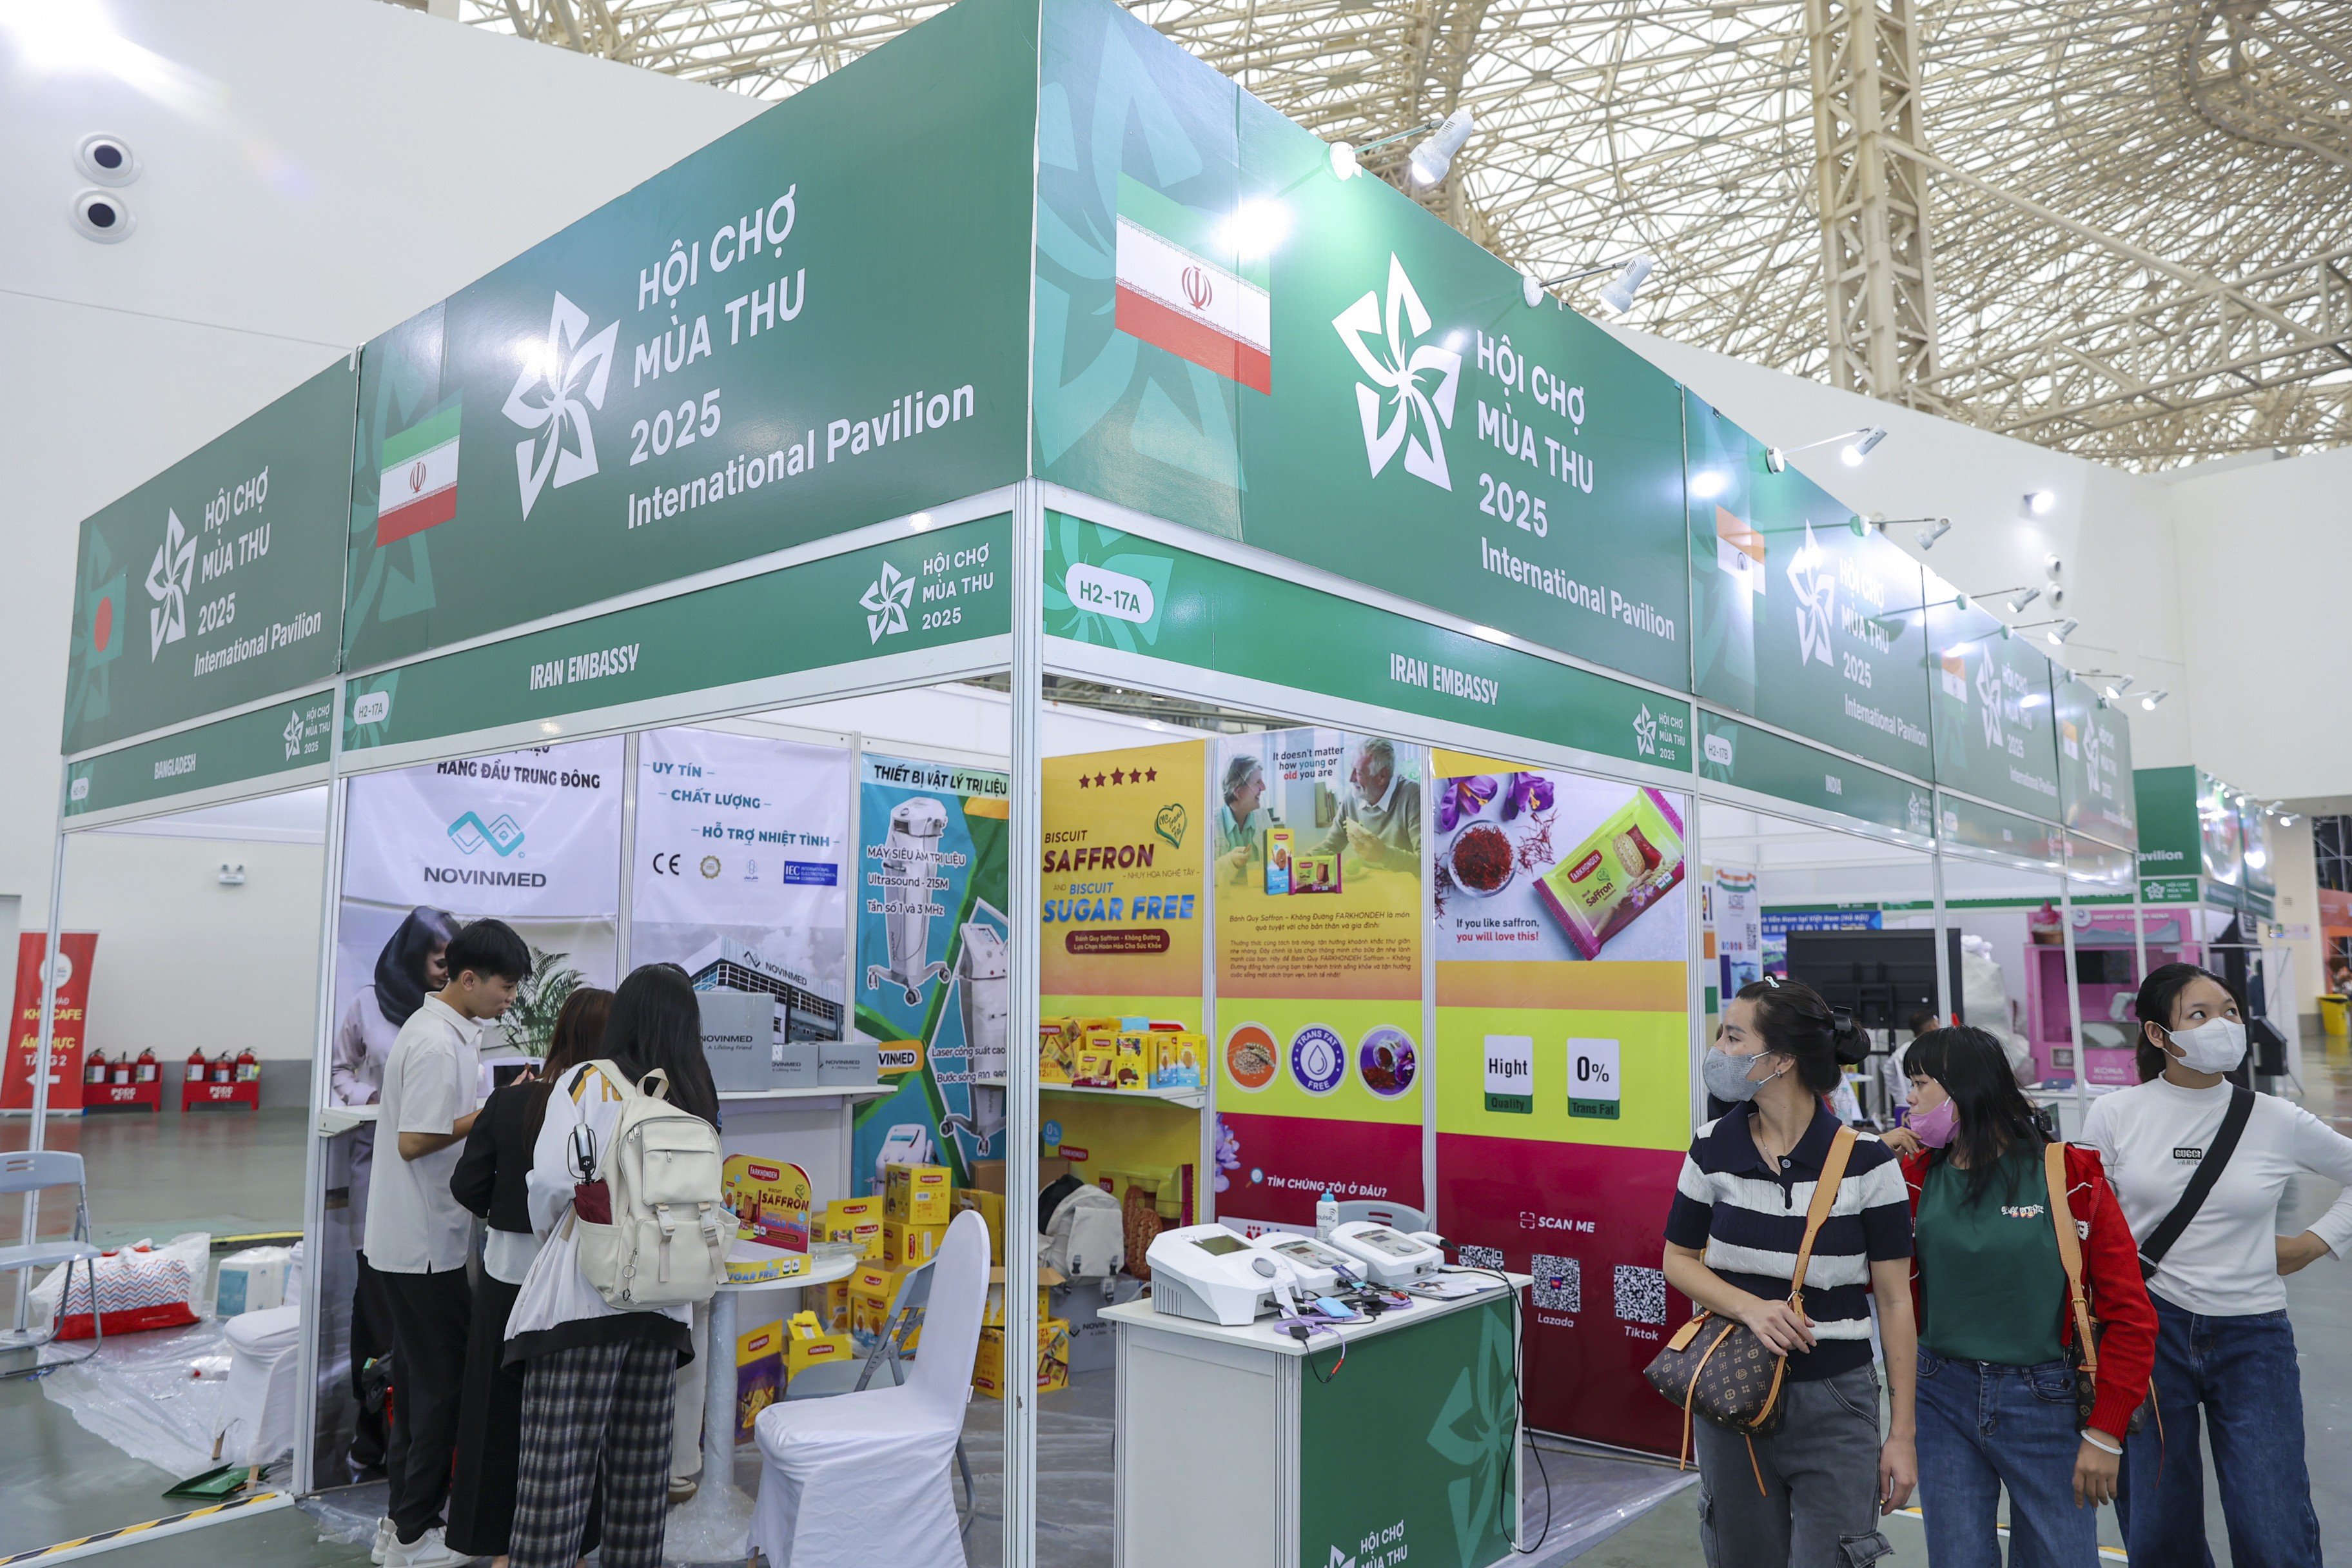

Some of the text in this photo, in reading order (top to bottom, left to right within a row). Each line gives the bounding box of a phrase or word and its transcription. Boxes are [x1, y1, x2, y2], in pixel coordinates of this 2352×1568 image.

[638, 183, 796, 311] HỘI CHỢ
[634, 268, 805, 387] MÙA THU
[1476, 329, 1585, 437] HỘI CHỢ
[629, 387, 721, 466] 2025
[628, 384, 974, 529] International Pavilion
[1478, 400, 1594, 495] MÙA THU
[204, 465, 268, 534] HỘI CHỢ
[1479, 473, 1548, 538] 2025
[201, 522, 270, 583] MÙA THU
[923, 542, 989, 577] HỘI CHỢ
[922, 571, 994, 603] MÙA THU
[1079, 581, 1141, 614] H2-17A
[1481, 536, 1675, 642] International Pavilion
[1839, 557, 1885, 616] HỘI CHỢ
[197, 592, 235, 636] 2025
[922, 609, 962, 630] 2025
[1841, 602, 1889, 654] MÙA THU
[194, 612, 321, 677] International Pavilion
[529, 643, 640, 691] IRAN EMBASSY
[1843, 651, 1872, 689] 2025
[1389, 652, 1498, 707] IRAN EMBASSY
[306, 703, 330, 722] HỘI CHỢ
[358, 703, 382, 718] H2-17A
[1845, 693, 1928, 747] International Pavilion
[305, 721, 331, 738] MÙA THU
[1658, 712, 1683, 732] HỘI CHỢ
[304, 741, 318, 754] 2025
[1659, 729, 1685, 747] MÙA THU
[1273, 747, 1344, 761] It doesn't matter
[1660, 748, 1675, 761] 2025
[1709, 744, 1728, 760] H2-17B
[153, 753, 197, 779] BANGLADESH
[481, 759, 510, 781] ĐẦU
[514, 766, 557, 786] TRUNG
[560, 769, 600, 789] ĐÔNG
[652, 761, 701, 778] UY TÍN
[1279, 761, 1297, 770] how
[1298, 760, 1326, 771] young
[1284, 769, 1333, 781] old you are
[874, 764, 1007, 797] THIẾT BỊ VẬT LÝ TRỊ LIỆU
[1825, 774, 1842, 796] INDIA
[671, 788, 761, 810] CHẤT LƯỢNG
[703, 822, 830, 847] HỖ TRỢ NHIỆT TÌNH
[1044, 830, 1088, 843] BISCUIT
[867, 845, 890, 859] MÁY
[892, 847, 914, 861] SIÊU
[945, 854, 966, 868] LIỆU
[1043, 843, 1154, 874] SAFFRON
[2137, 850, 2183, 861] avilion
[424, 867, 547, 887] NOVINMED
[785, 865, 800, 876] IEC
[868, 874, 919, 887] Ultrasound
[1070, 882, 1114, 896] BISCUIT
[1586, 882, 1614, 906] Saffron
[905, 903, 915, 914] và
[917, 904, 923, 914] 3
[925, 905, 943, 915] MHz
[1043, 894, 1195, 923] SUGAR FREE
[1456, 917, 1540, 930] If you like saffron,
[1456, 931, 1539, 943] you will love this!
[765, 962, 807, 986] NOVINMED
[23, 1008, 83, 1021] KH CAFE
[701, 1035, 753, 1044] NOVINMED
[1297, 1030, 1338, 1047] TRANS FAT
[878, 1052, 914, 1064] VINMED
[932, 1048, 953, 1057] Laser
[1488, 1057, 1528, 1079] Hight
[1576, 1055, 1609, 1083] 0%
[1308, 1079, 1331, 1090] FREE
[1491, 1097, 1525, 1111] Quality
[1572, 1101, 1614, 1117] Trans Fat
[2175, 1150, 2200, 1158] GUCCI
[1267, 1175, 1286, 1188] TÌM
[1287, 1177, 1325, 1191] CHÚNG
[1328, 1181, 1346, 1193] TÔI
[1359, 1182, 1387, 1197] ĐÂU?
[761, 1193, 809, 1211] SAFFRON
[1538, 1216, 1595, 1233] SCAN ME
[1537, 1314, 1574, 1328] Lazada
[1624, 1326, 1660, 1340] Tiktok
[1360, 1519, 1404, 1554] HỘI CHỢ
[1386, 1544, 1407, 1567] THU
